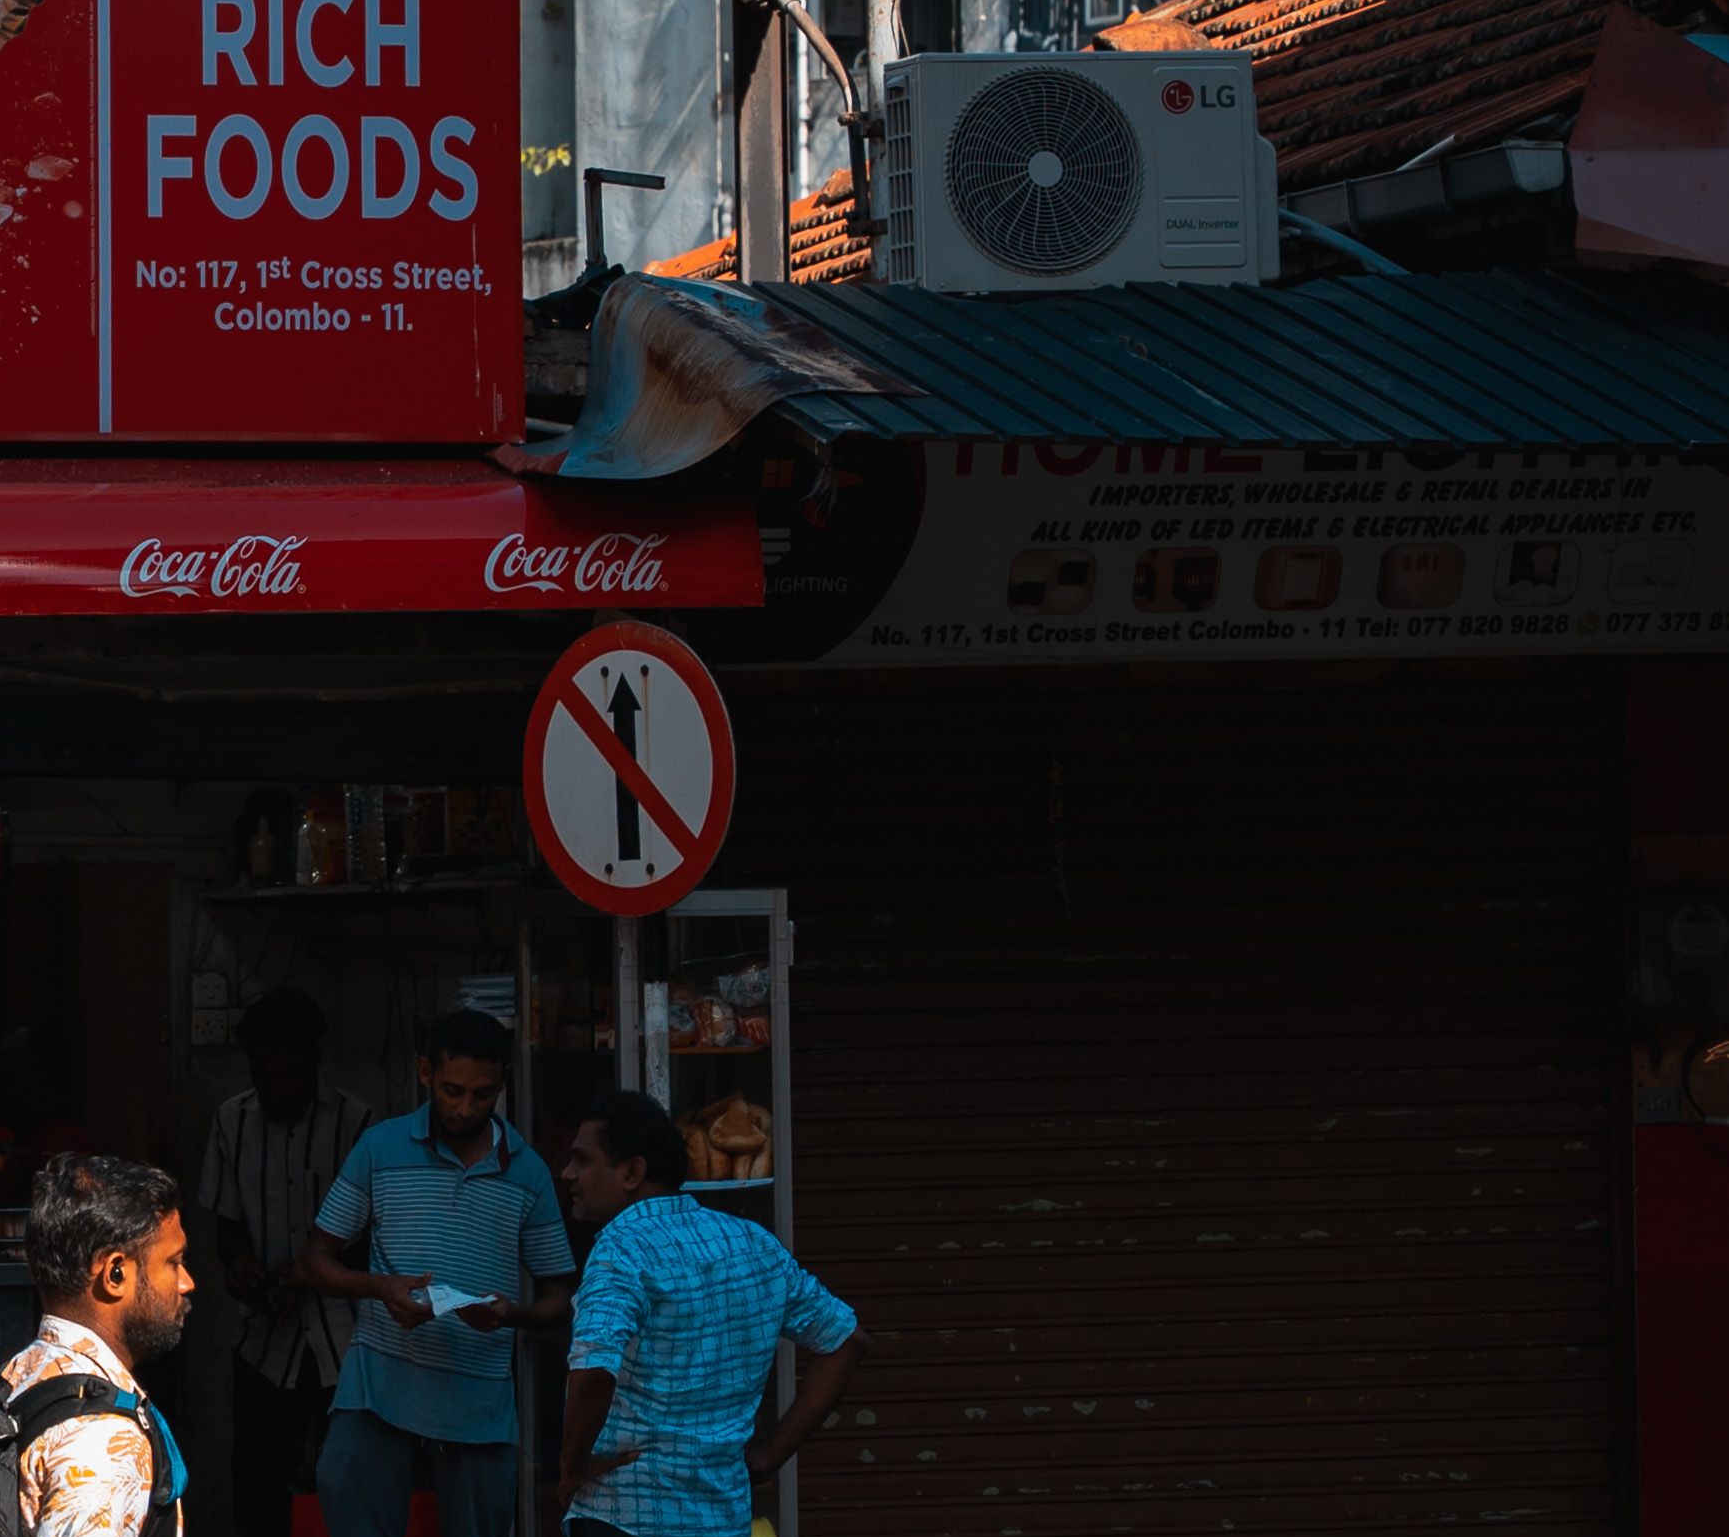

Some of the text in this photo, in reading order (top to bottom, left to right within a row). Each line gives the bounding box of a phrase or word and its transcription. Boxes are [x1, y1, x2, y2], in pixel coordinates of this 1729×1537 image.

[1200, 84, 1236, 109] LG
[146, 114, 479, 222] FOODS
[1166, 218, 1240, 230] DUAL Inverter
[135, 255, 493, 297] No: 117, 1st Cross Street,
[214, 301, 351, 331] Colombo
[381, 302, 414, 331] 11.
[1089, 477, 1652, 509] IMPORTERS, WHOLESALE & RETAIL DEALERS IN
[1031, 511, 1697, 543] ALL KIND OF LED ITEMS & ELECTRICAL APPLIANCES ETC.
[119, 535, 309, 597] Coca-Cola
[484, 533, 671, 592] Coca-Cola
[871, 626, 910, 647] No.
[921, 624, 971, 650] 117,
[981, 623, 1019, 645] 1st
[1027, 622, 1096, 644] Cross
[1104, 621, 1182, 643] Street
[1188, 619, 1295, 641] Colombo
[1319, 618, 1346, 638] 11
[1356, 617, 1398, 638] Tel:
[1407, 615, 1452, 636] 077
[1458, 615, 1503, 636] 820
[1509, 614, 1569, 635] 9826
[1607, 612, 1650, 633] 077
[1657, 612, 1701, 632] 375
